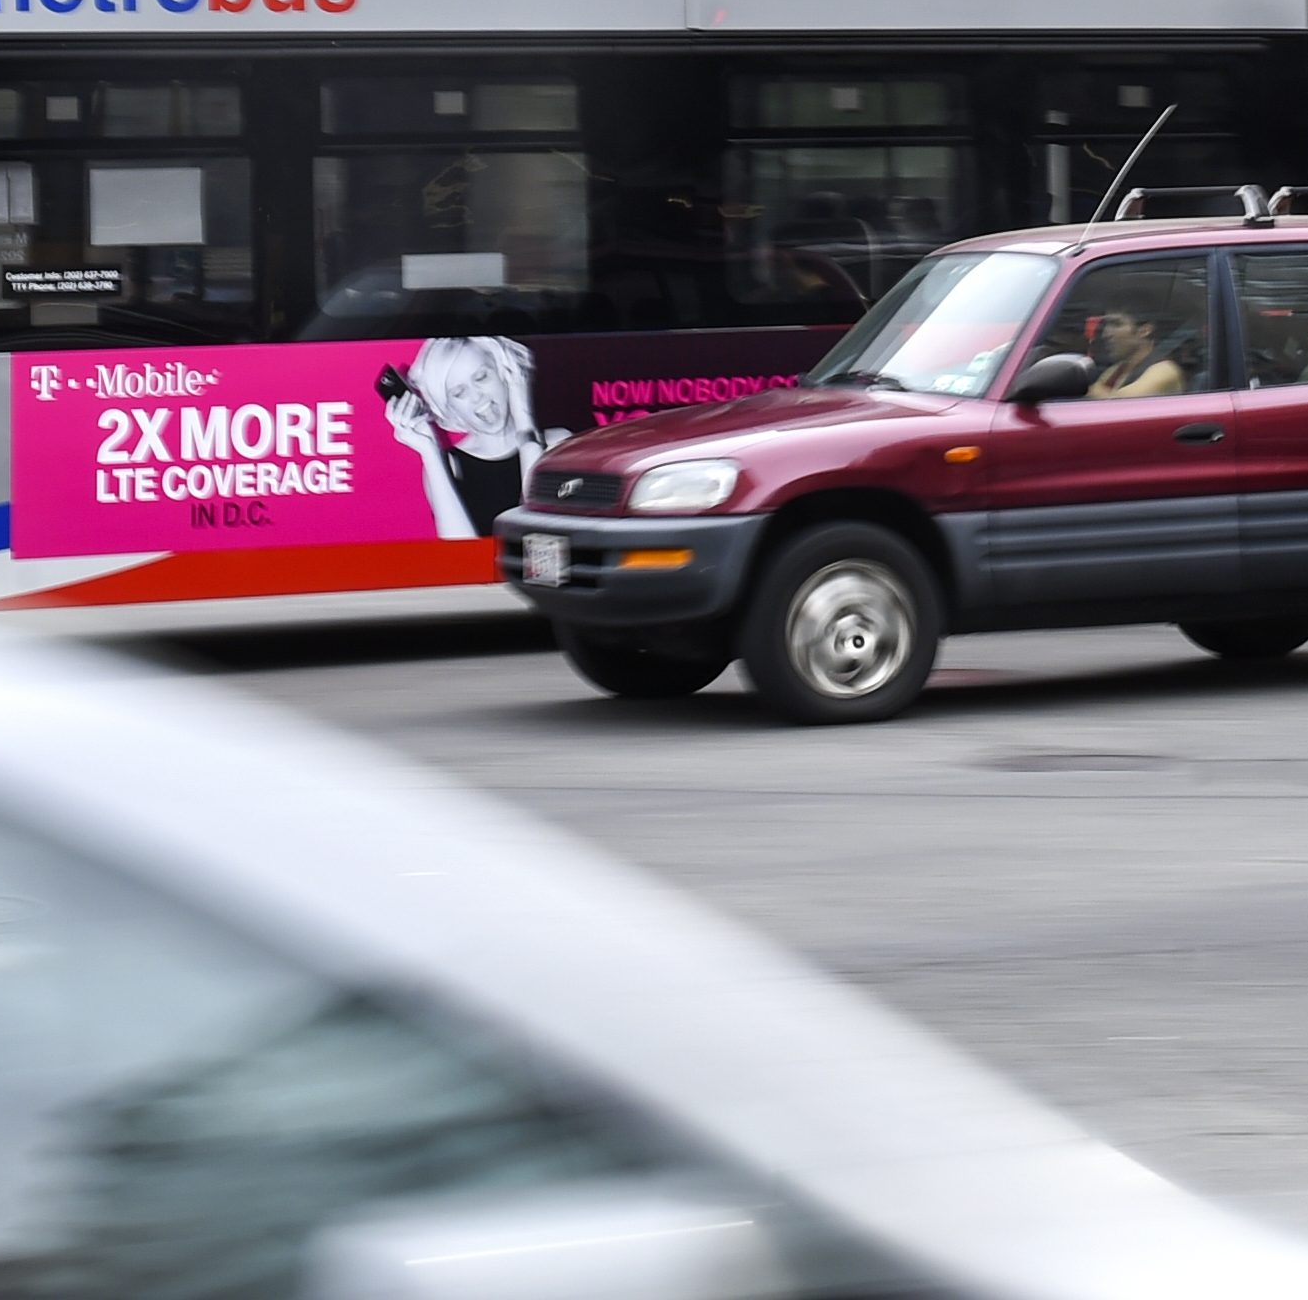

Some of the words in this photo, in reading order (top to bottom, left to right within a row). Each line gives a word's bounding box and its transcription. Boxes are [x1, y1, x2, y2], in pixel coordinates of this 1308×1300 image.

[5, 270, 42, 281] Customer
[63, 270, 83, 280] (202)
[84, 269, 119, 280] 637-7000
[57, 281, 77, 290] (202)
[592, 379, 653, 406] NOW
[658, 374, 764, 405] NOBODY
[96, 408, 172, 464] 2X
[180, 401, 354, 461] MORE
[96, 468, 159, 503] LTE
[162, 459, 354, 501] COVERAGE
[191, 503, 215, 528] IN
[223, 500, 273, 528] D.C.
